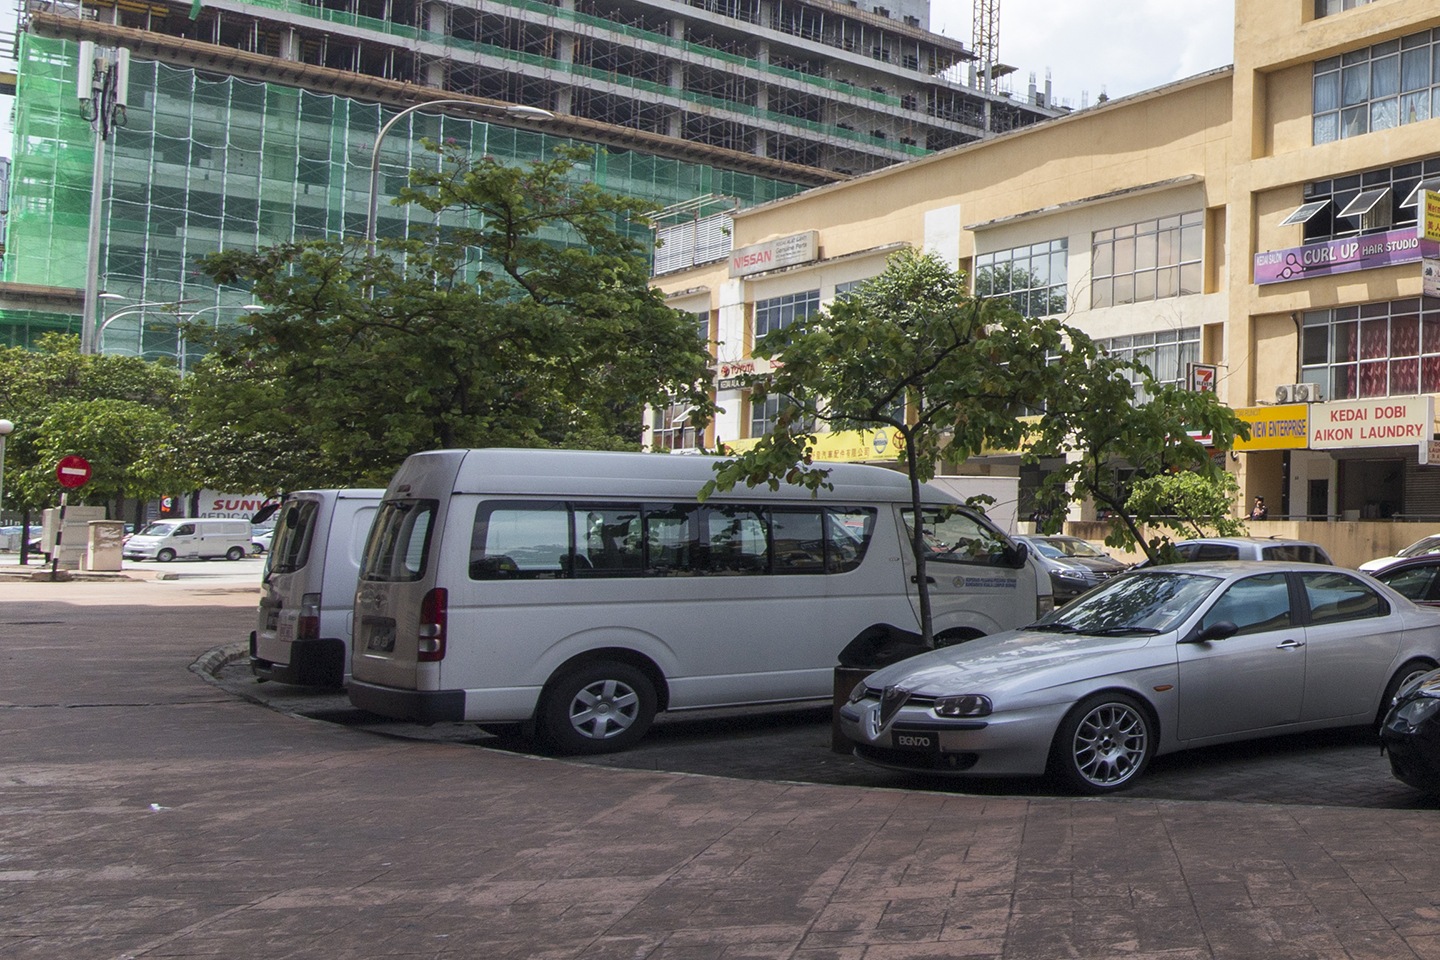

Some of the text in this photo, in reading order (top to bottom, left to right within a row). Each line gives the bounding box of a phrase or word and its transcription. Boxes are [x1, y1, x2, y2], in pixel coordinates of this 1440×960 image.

[733, 249, 772, 270] NISSAN
[1269, 252, 1283, 263] SALON
[1303, 237, 1419, 265] CURL UP HAIR STUDIO
[1330, 405, 1406, 422] KEDAI DOBI
[1268, 419, 1306, 437] ENTERPRISE
[1314, 423, 1424, 442] AIKON LAUNDRY
[898, 736, 931, 747] BGN70
